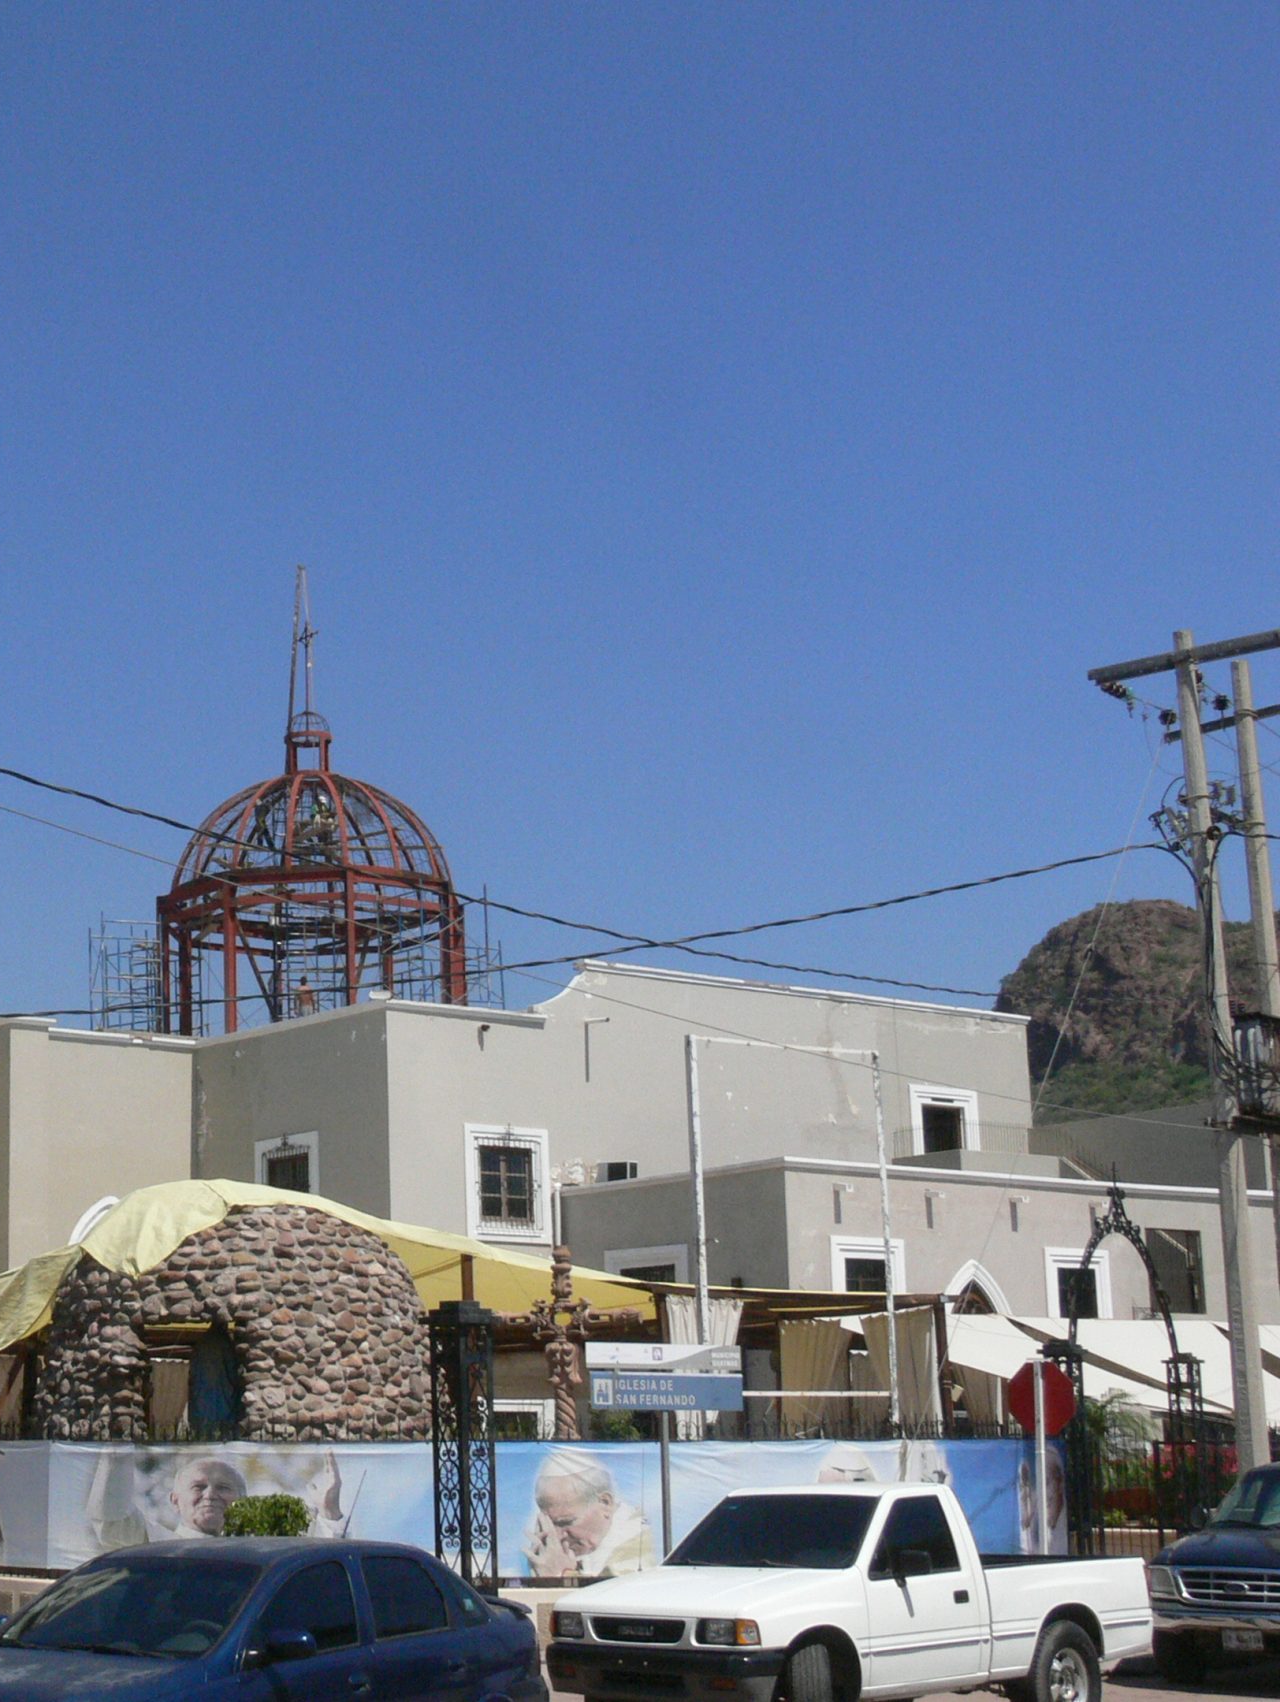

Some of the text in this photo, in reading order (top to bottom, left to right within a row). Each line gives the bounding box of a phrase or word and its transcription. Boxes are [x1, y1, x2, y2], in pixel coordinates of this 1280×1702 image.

[614, 1379, 673, 1391] IGLESIA DE
[615, 1393, 696, 1406] SAN FERNANDO
